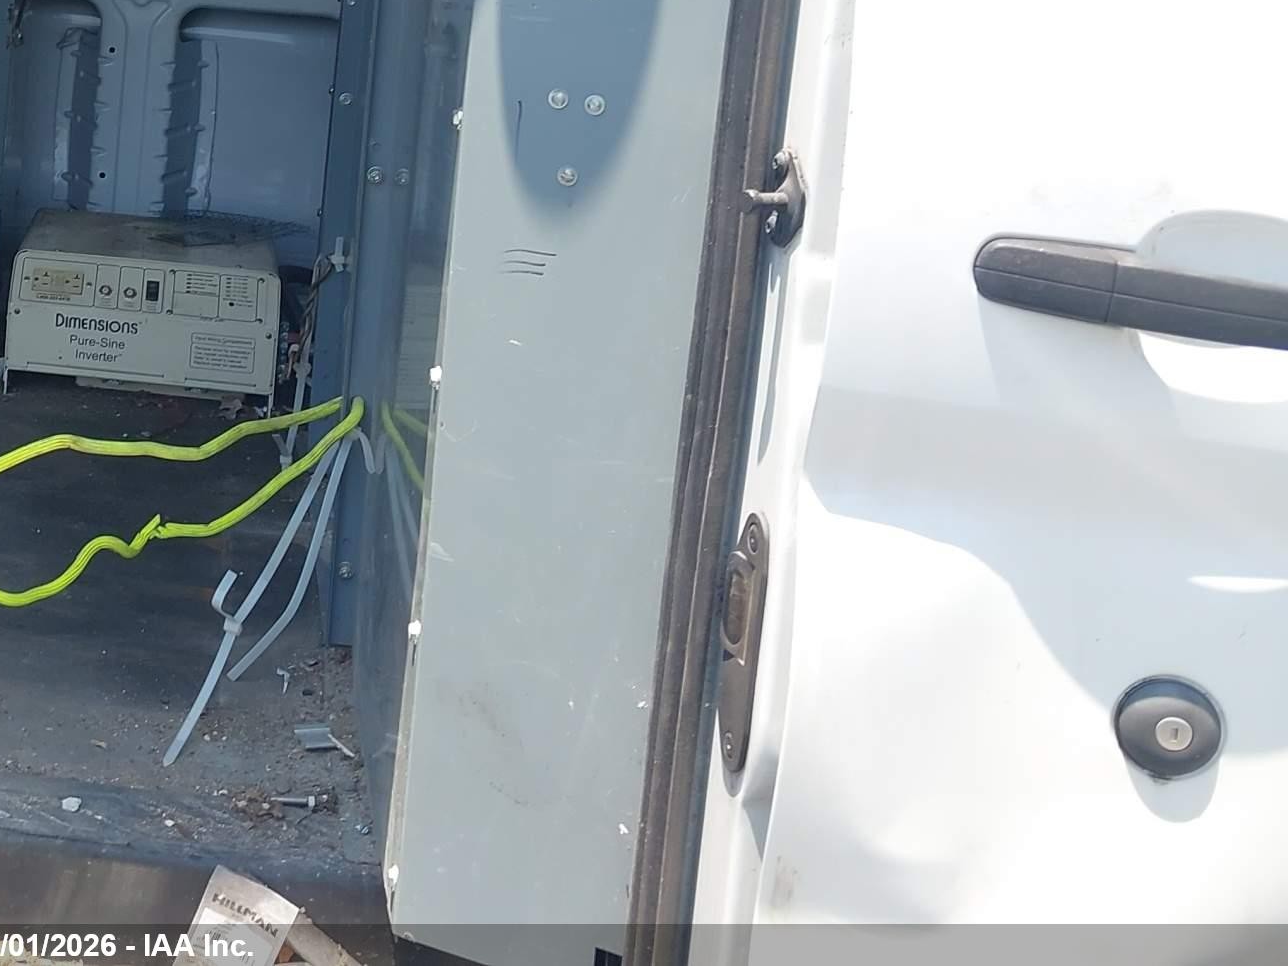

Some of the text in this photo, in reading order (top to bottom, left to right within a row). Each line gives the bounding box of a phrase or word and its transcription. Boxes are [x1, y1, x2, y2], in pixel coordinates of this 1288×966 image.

[70, 336, 126, 350] Pure-Sine
[76, 350, 120, 364] Inverter
[212, 893, 279, 938] HILLMAN
